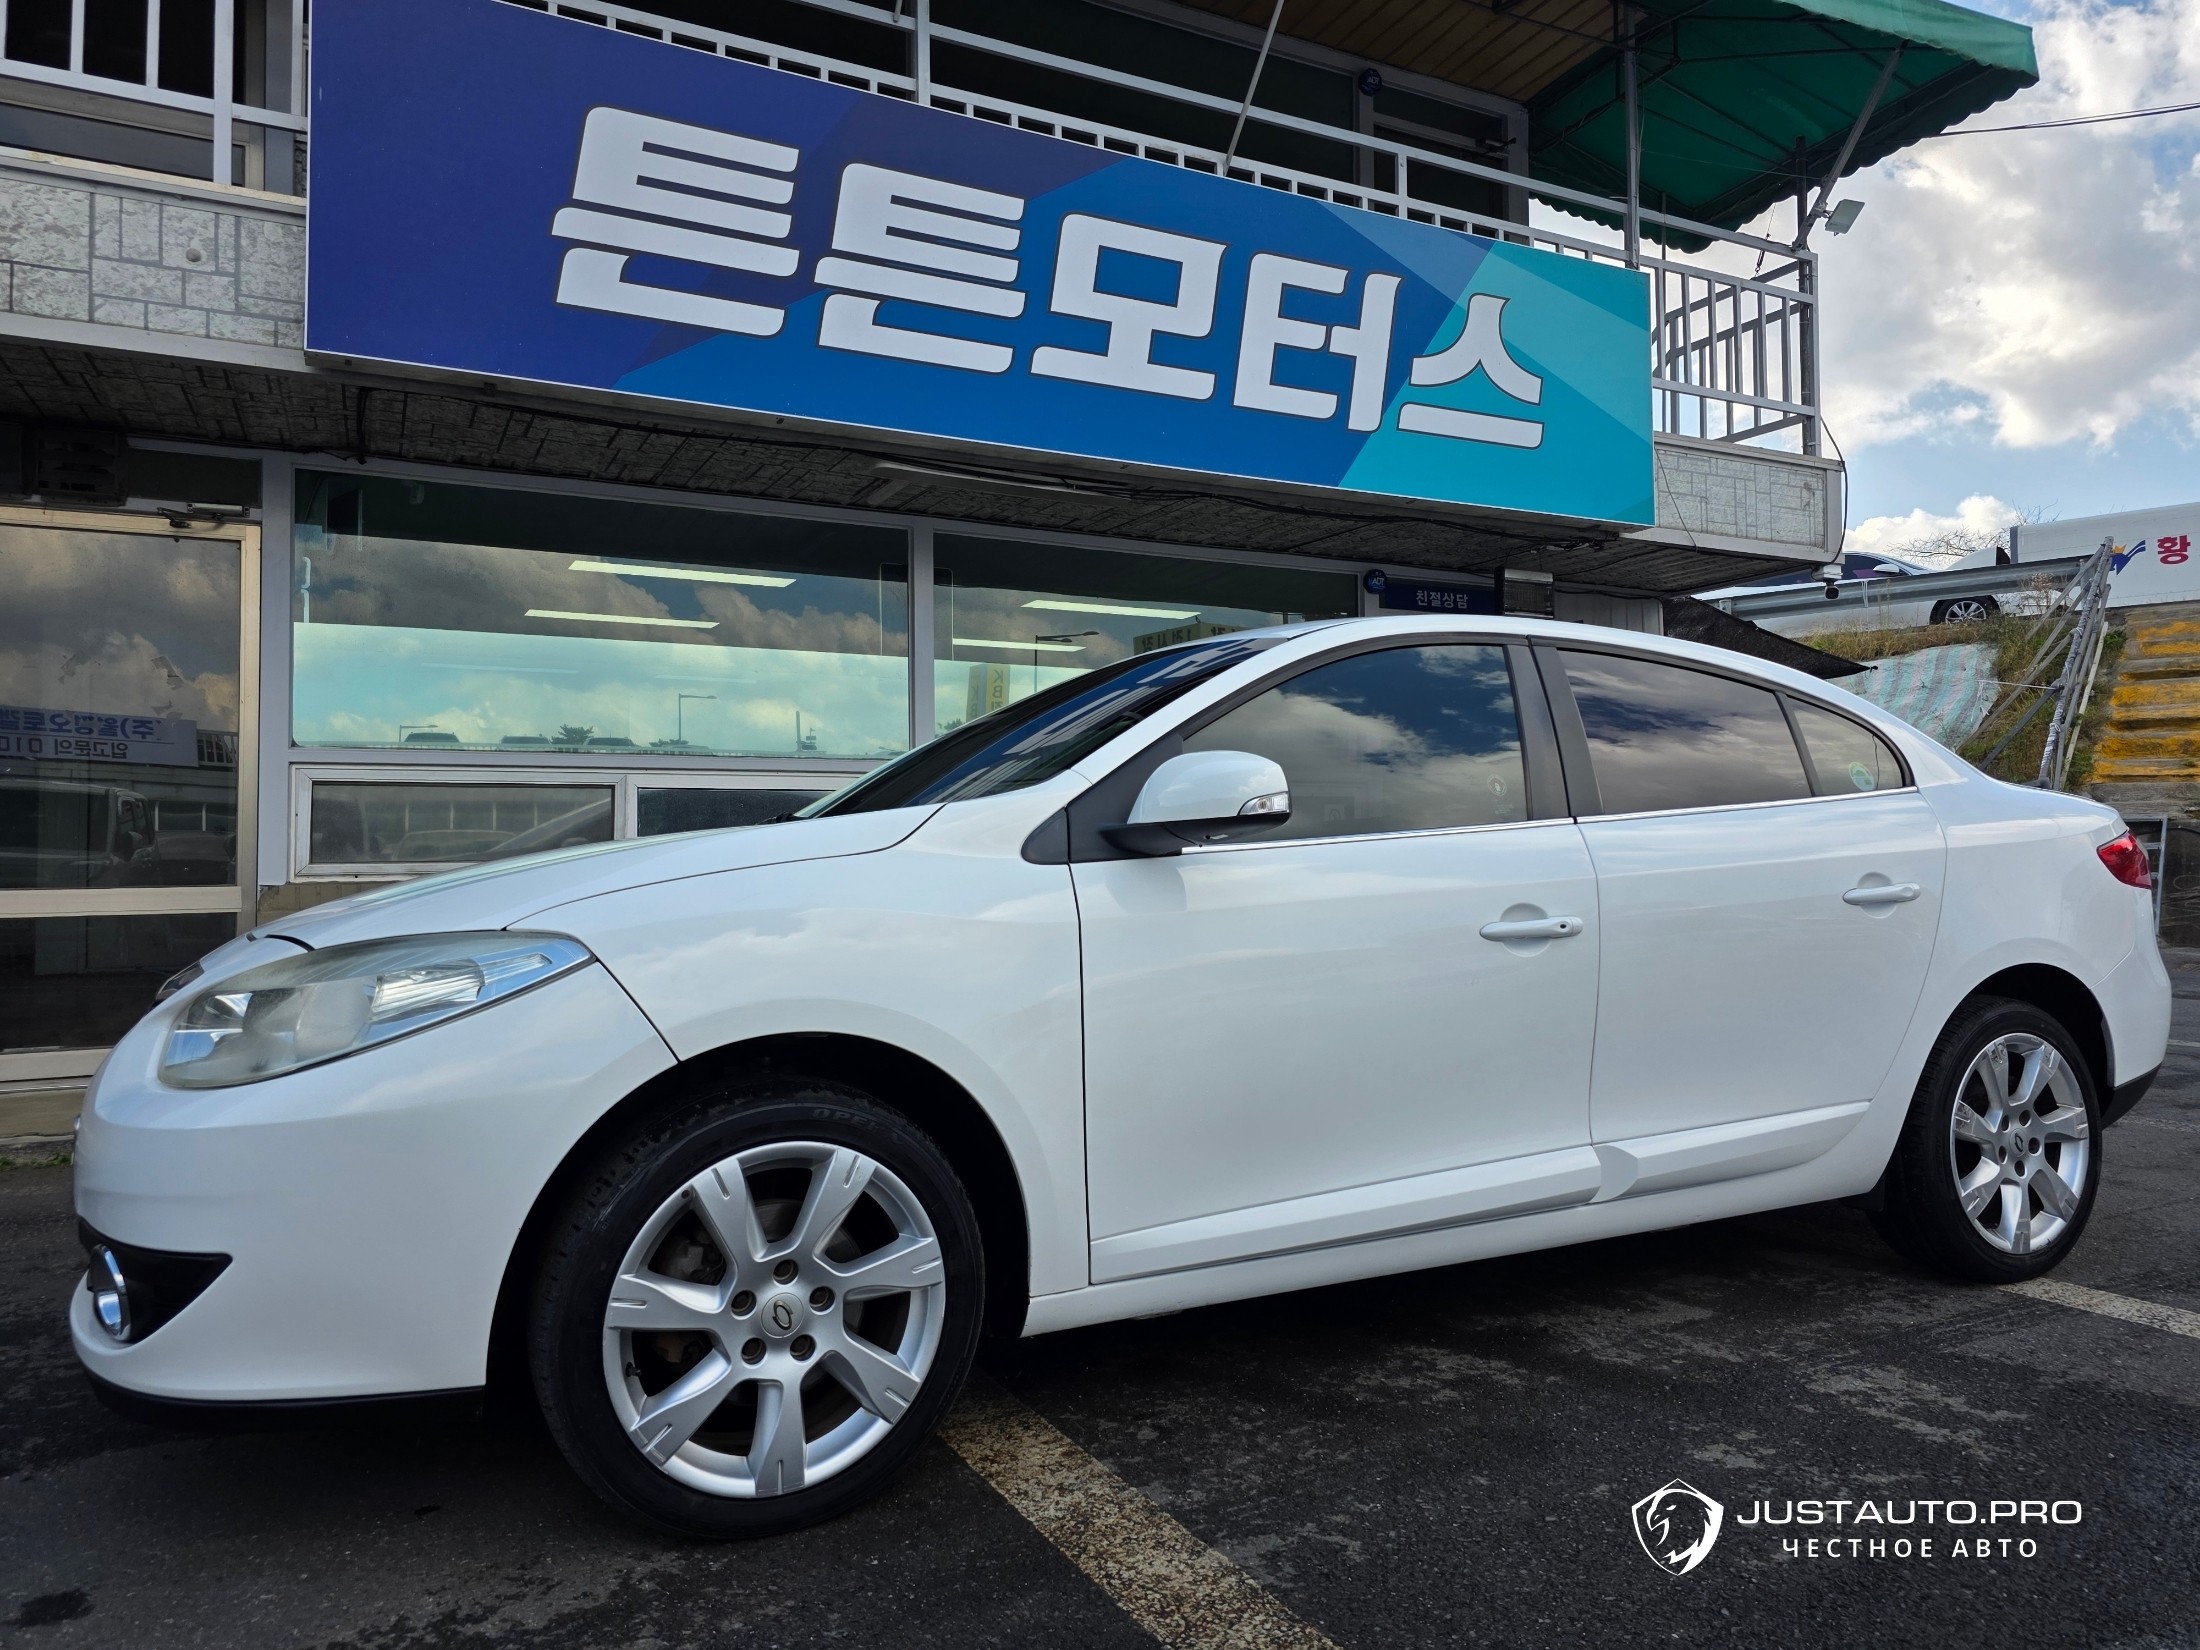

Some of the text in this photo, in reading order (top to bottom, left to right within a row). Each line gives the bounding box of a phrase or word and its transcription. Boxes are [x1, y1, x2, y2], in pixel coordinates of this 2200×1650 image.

[551, 105, 1545, 450] 튼튼모터스
[2157, 534, 2191, 565] 황
[1371, 577, 1385, 586] ADT
[1416, 590, 1468, 609] 친절상담
